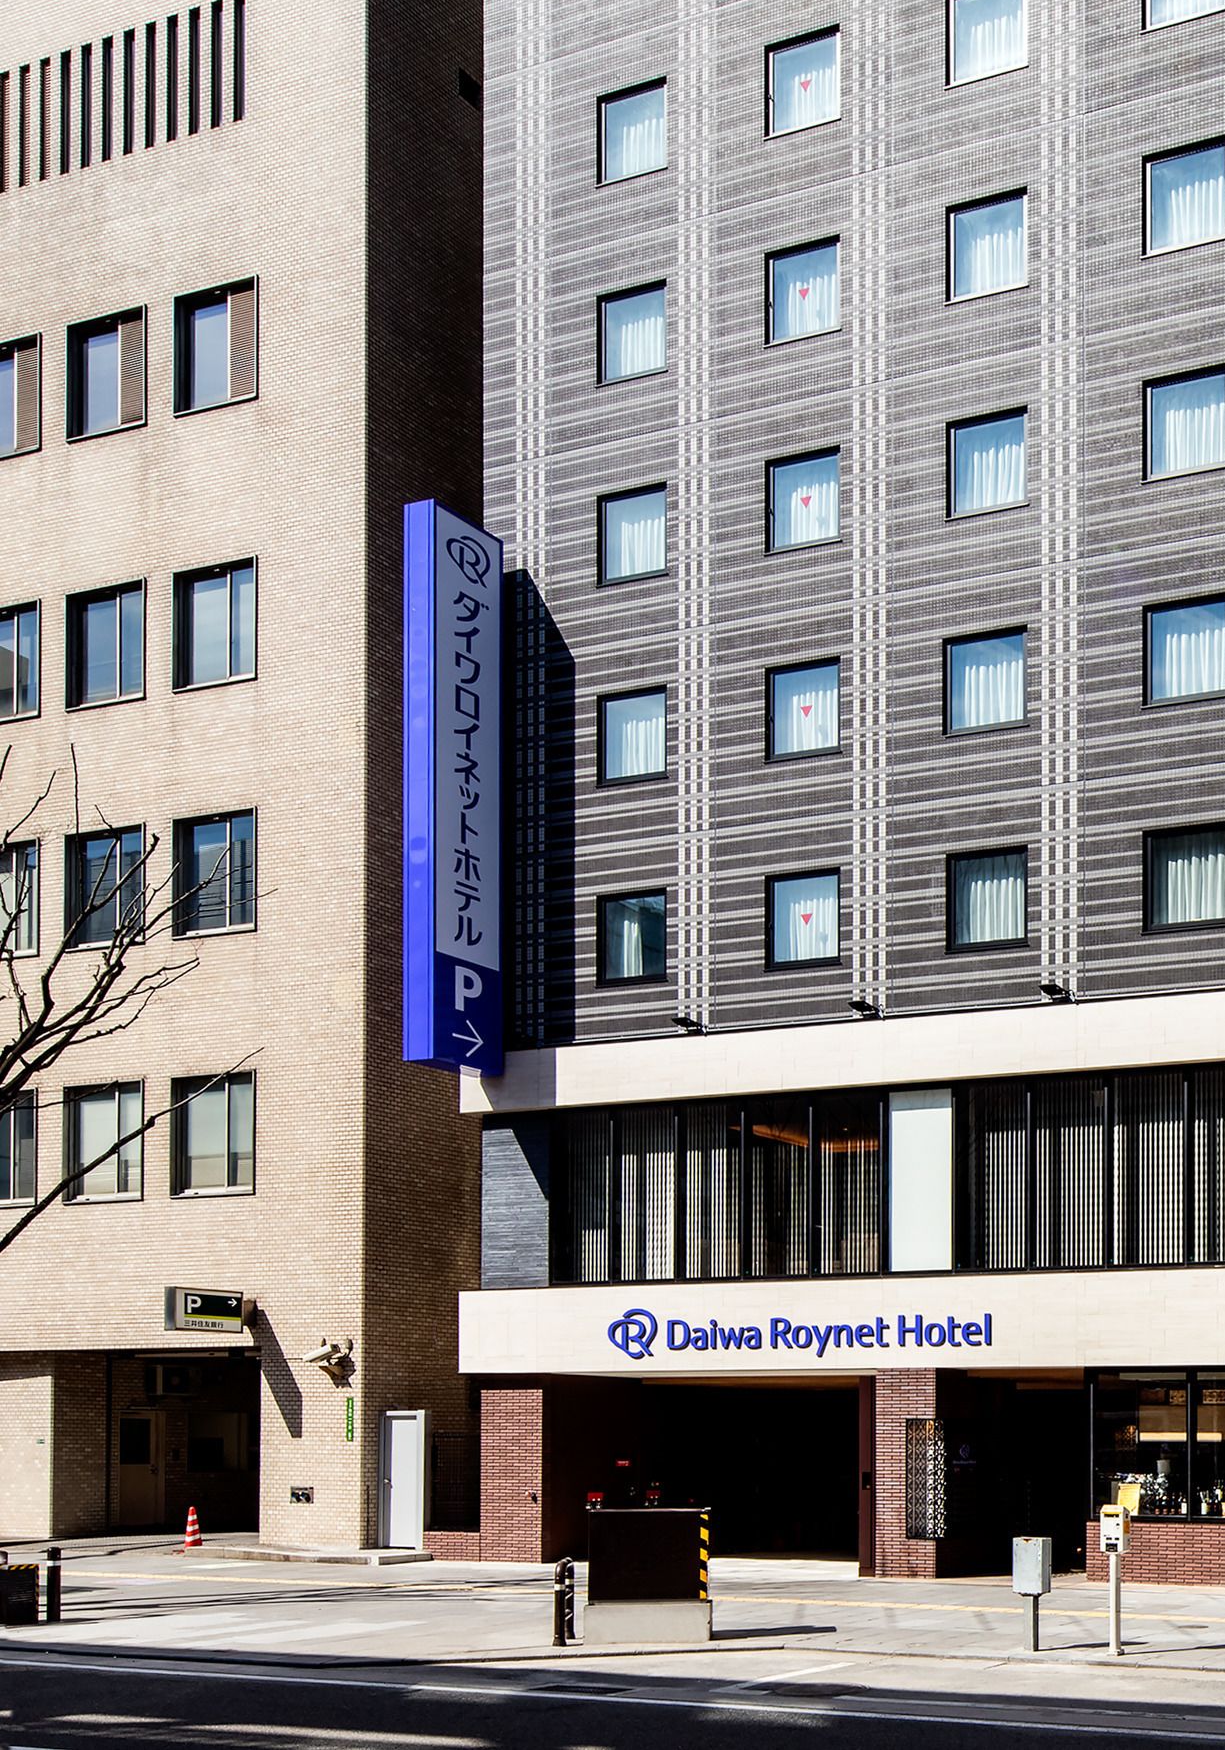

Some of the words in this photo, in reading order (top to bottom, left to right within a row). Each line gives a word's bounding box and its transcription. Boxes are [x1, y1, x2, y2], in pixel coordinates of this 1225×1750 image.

[453, 590, 490, 947] ダイワロイネットホテル
[455, 965, 482, 1011] P
[187, 1295, 202, 1313] P
[667, 1319, 762, 1350] Daiwa
[770, 1317, 889, 1357] Roynet
[898, 1313, 992, 1348] Hotel
